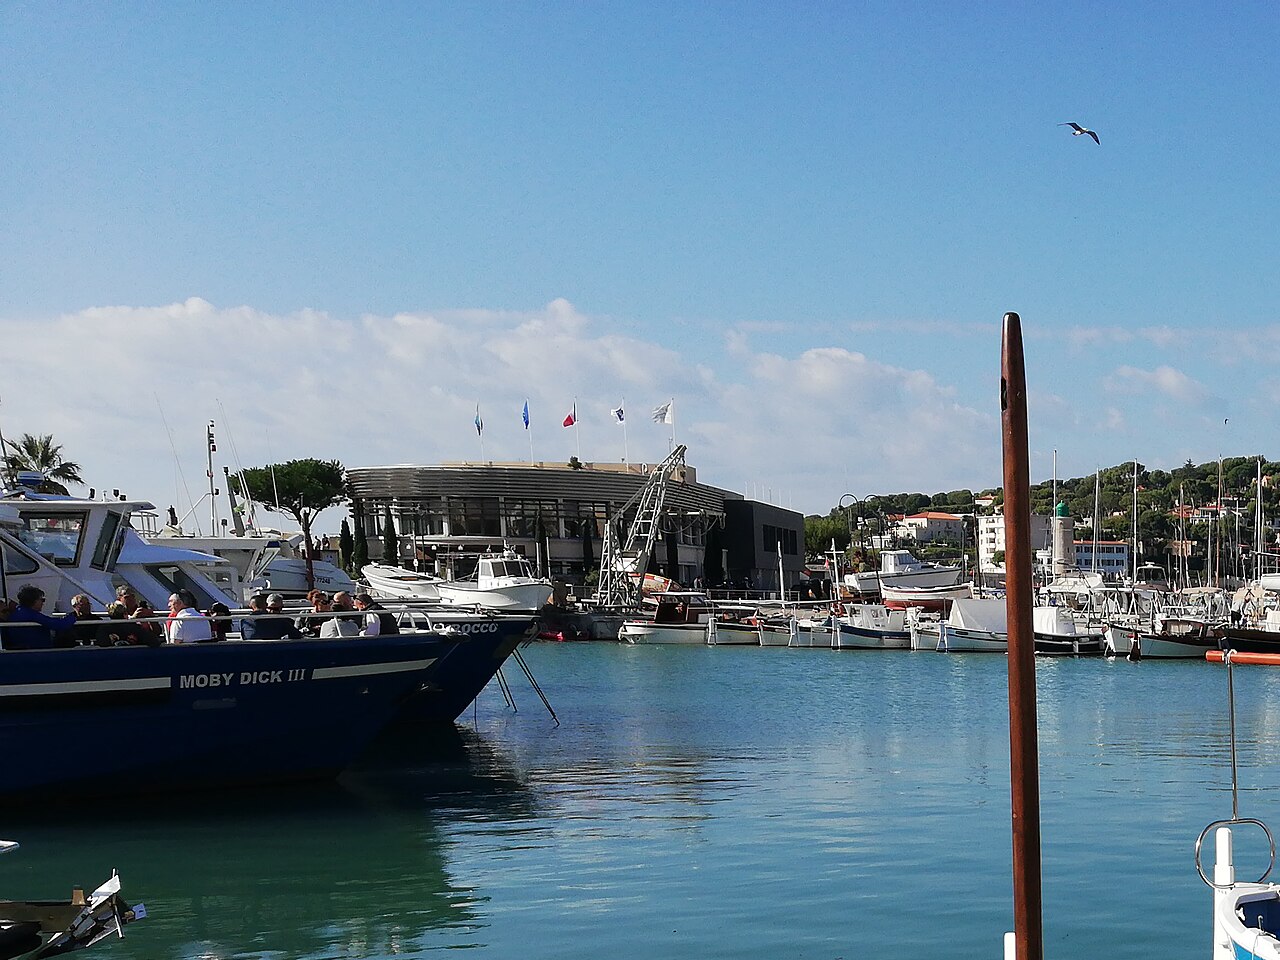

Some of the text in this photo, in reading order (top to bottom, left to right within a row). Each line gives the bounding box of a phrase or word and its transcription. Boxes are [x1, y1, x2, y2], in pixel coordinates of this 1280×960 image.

[179, 668, 307, 689] MOBY DICK III
